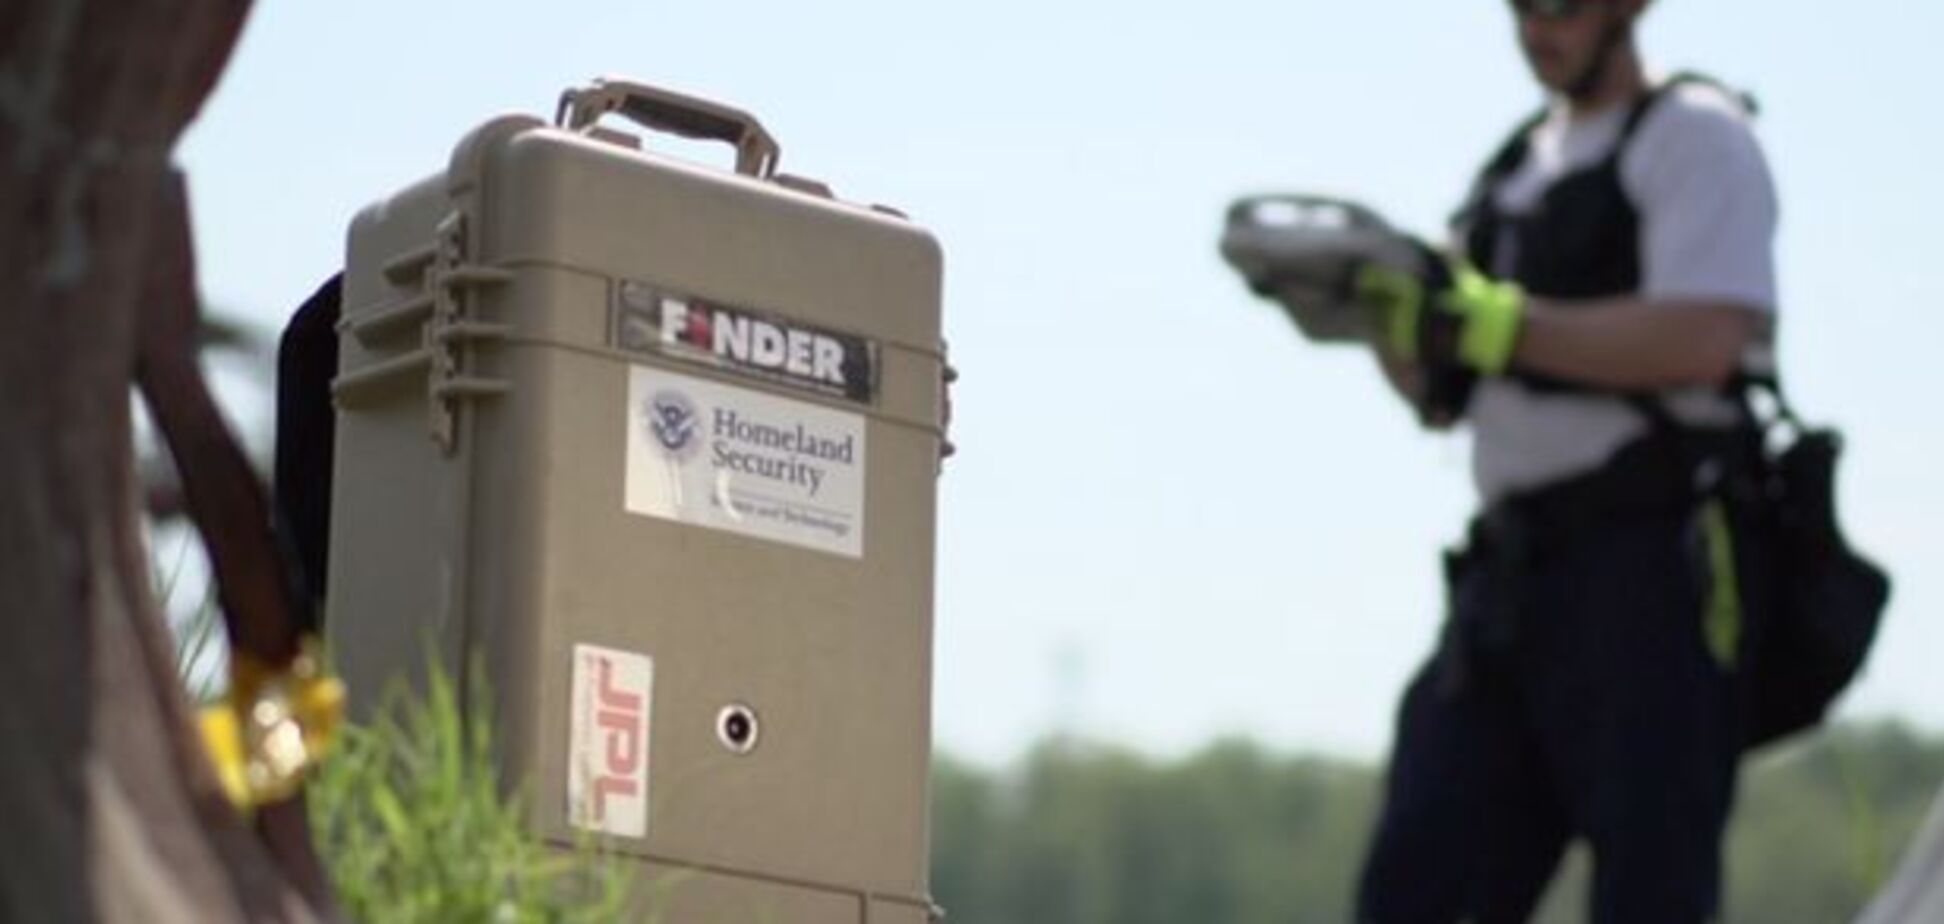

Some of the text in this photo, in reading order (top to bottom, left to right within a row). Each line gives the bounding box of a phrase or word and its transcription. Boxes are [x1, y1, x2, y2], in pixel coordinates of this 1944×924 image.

[712, 408, 854, 465] Homeland
[711, 441, 825, 497] Security
[594, 656, 642, 821] JPL
